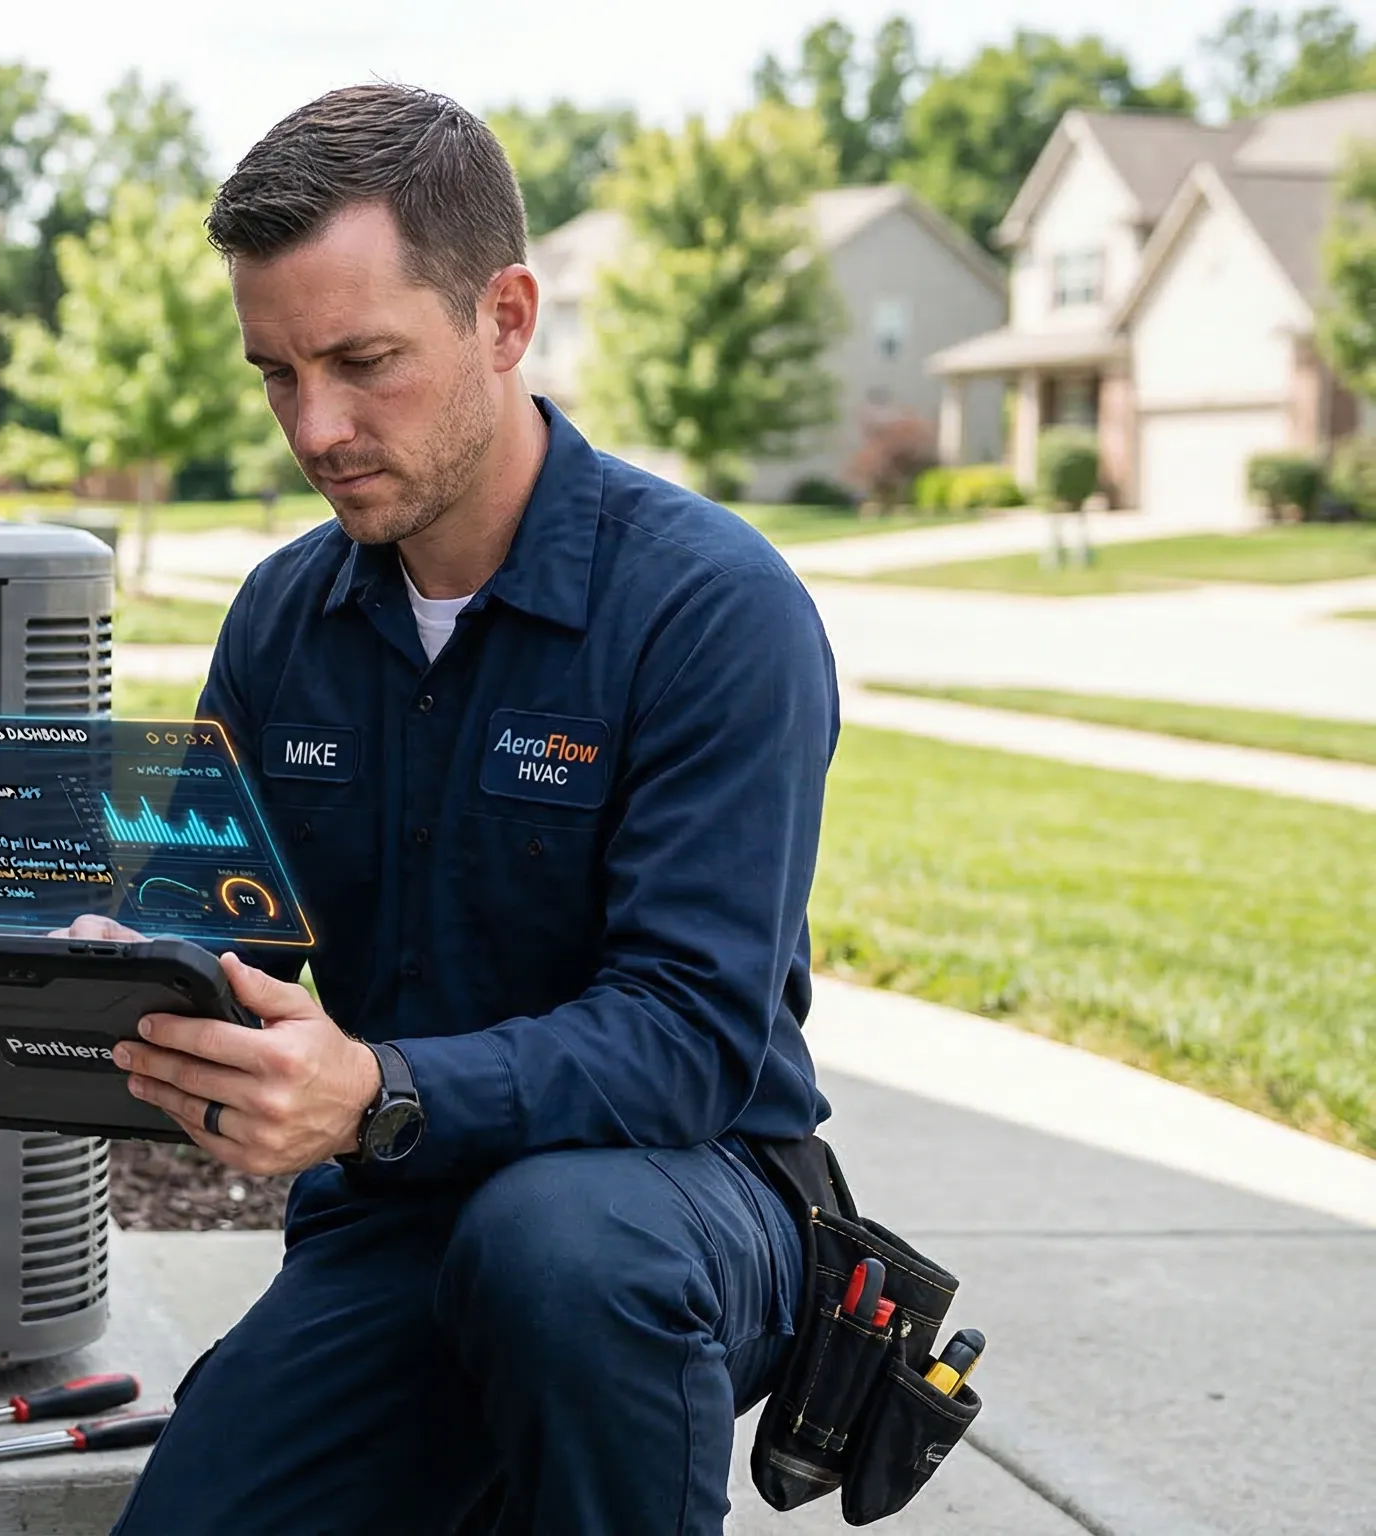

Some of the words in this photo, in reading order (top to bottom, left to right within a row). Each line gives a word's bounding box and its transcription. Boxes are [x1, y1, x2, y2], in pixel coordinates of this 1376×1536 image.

[6, 727, 88, 742] DASHBOARD
[494, 728, 599, 764] AeroFlow
[285, 741, 338, 767] MIKE
[518, 761, 569, 785] HVAC
[6, 1038, 113, 1059] Panthera
